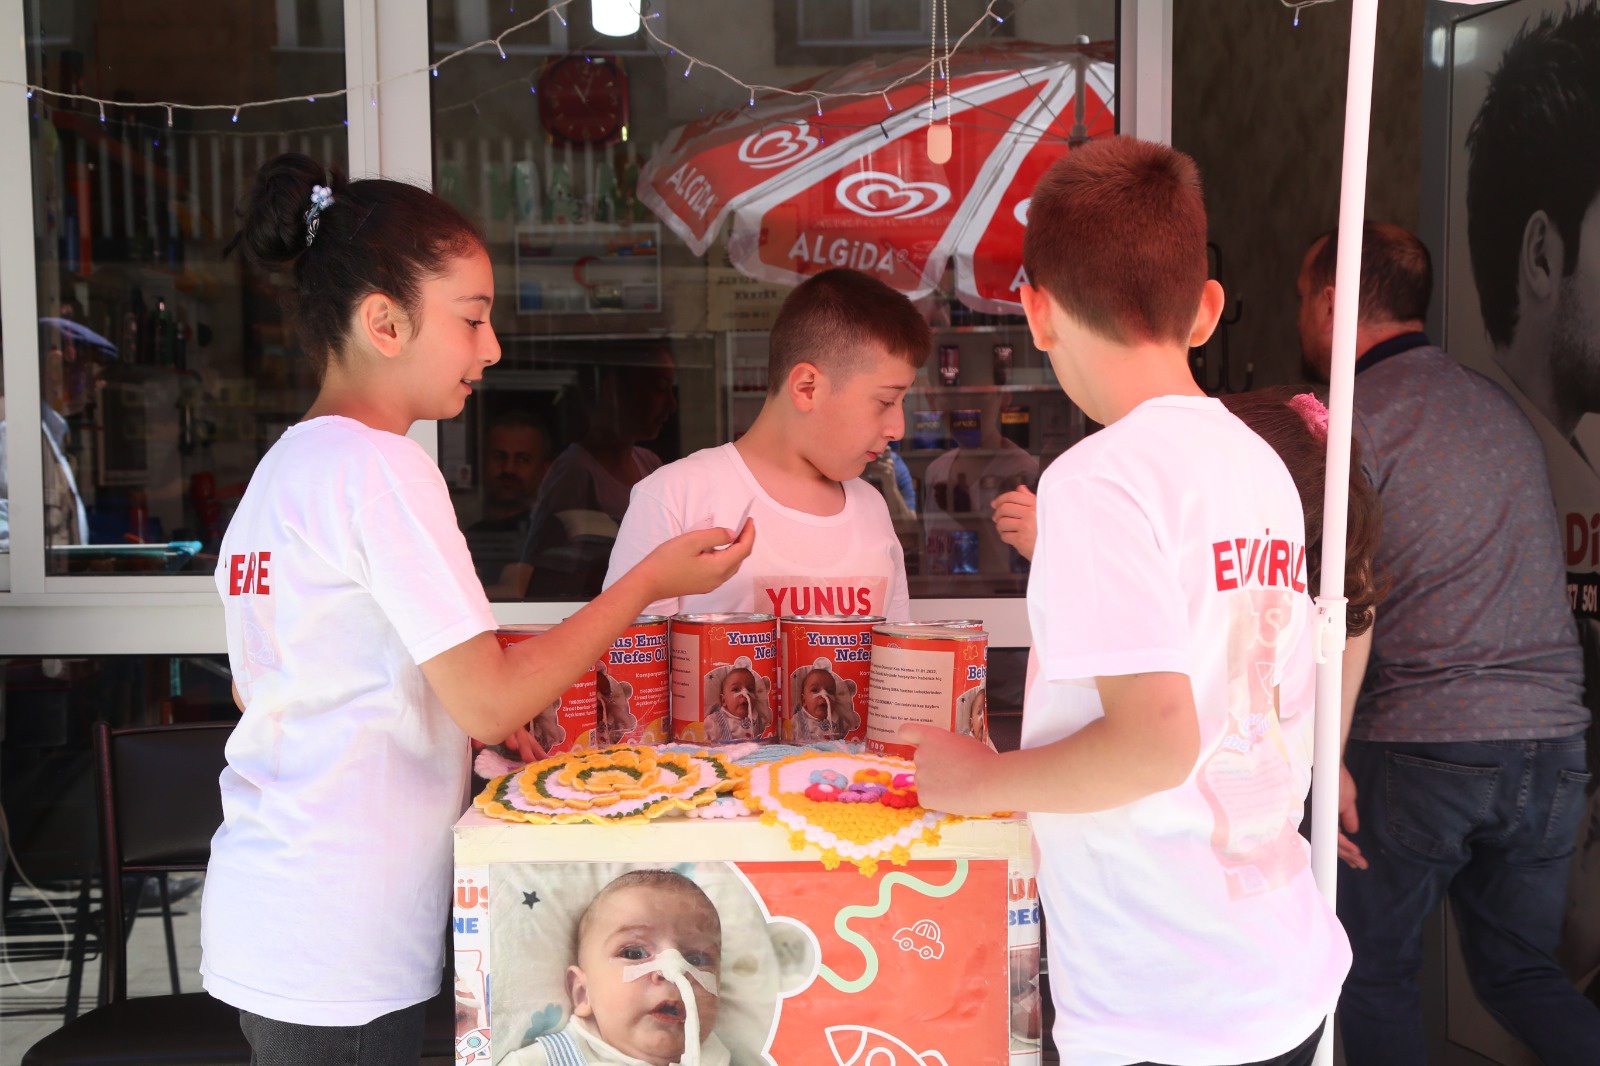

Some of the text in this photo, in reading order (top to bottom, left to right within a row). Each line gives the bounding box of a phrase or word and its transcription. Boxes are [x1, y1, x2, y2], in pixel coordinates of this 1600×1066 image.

[766, 587, 871, 617] YUNUS
[726, 631, 771, 645] Yunus
[806, 632, 857, 646] Yunus
[609, 650, 652, 664] Nefes
